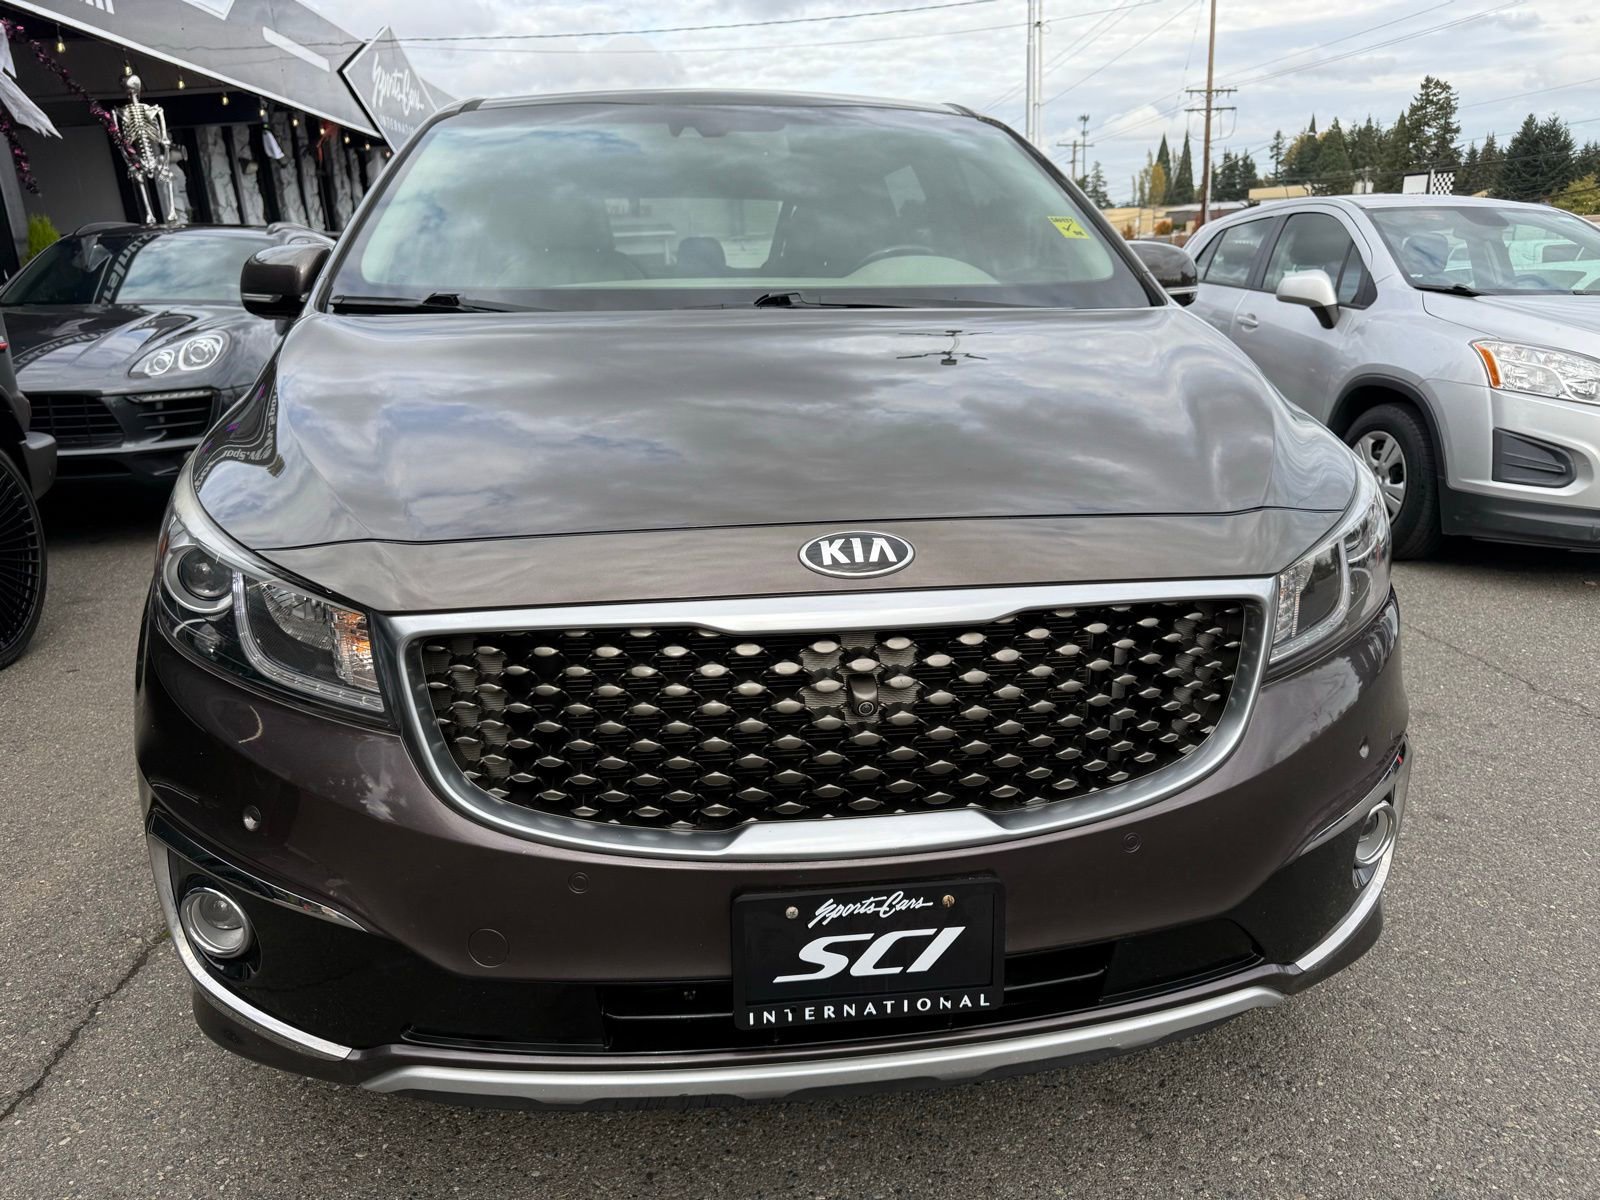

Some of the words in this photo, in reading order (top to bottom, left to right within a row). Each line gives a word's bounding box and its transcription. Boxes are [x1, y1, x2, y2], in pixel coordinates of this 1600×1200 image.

[818, 537, 898, 565] KIA
[807, 896, 886, 929] Sports
[879, 890, 934, 918] Cars
[772, 926, 966, 983] SCI
[749, 993, 990, 1025] INTERNATIONAL
